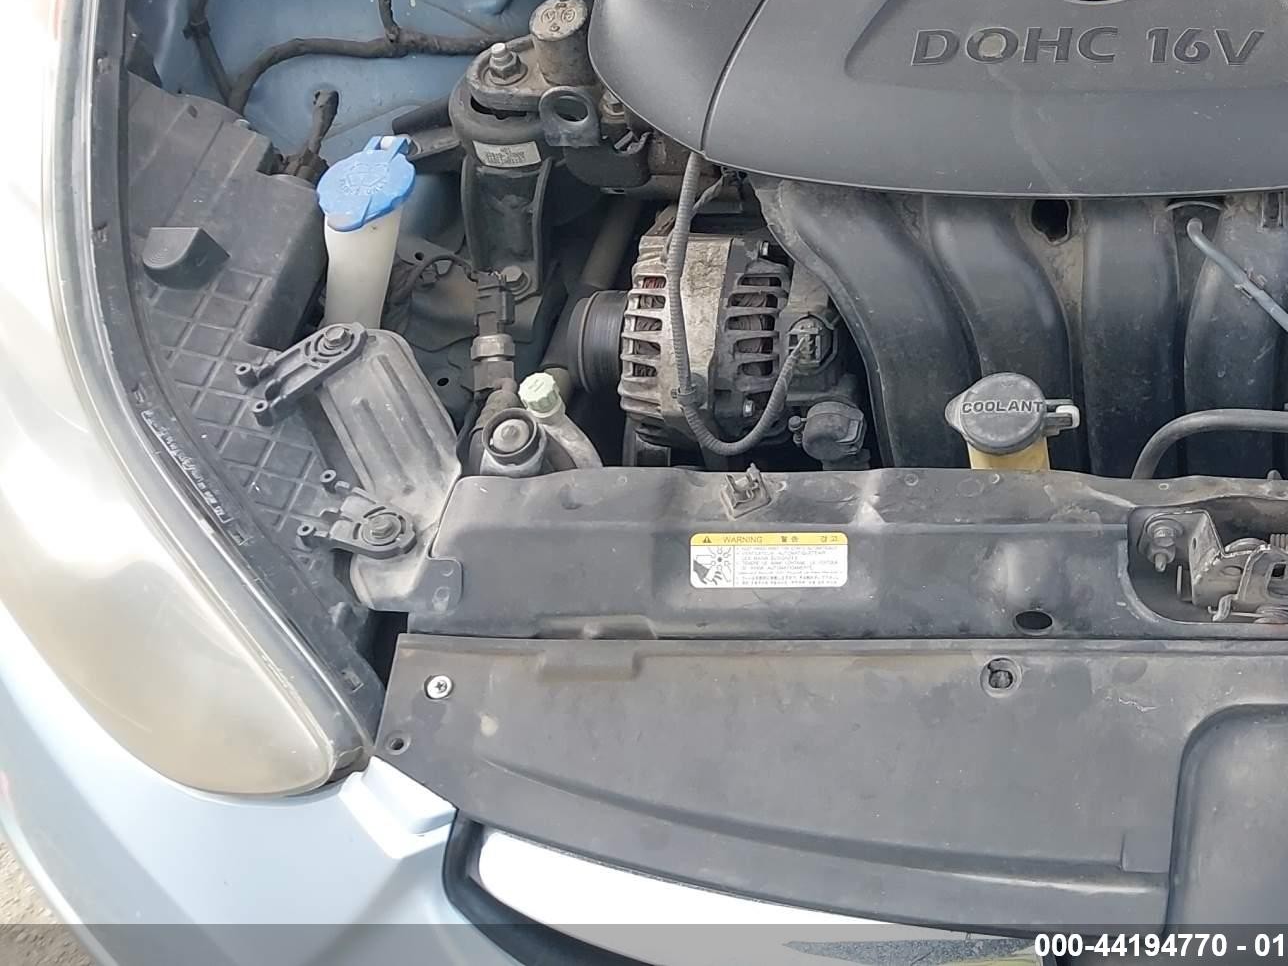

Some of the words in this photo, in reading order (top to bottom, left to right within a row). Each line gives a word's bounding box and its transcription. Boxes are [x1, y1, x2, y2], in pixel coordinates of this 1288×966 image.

[911, 25, 1118, 66] DOHC
[1146, 26, 1265, 66] 16V
[962, 400, 1043, 414] COOLANT
[723, 536, 763, 544] WARNING
